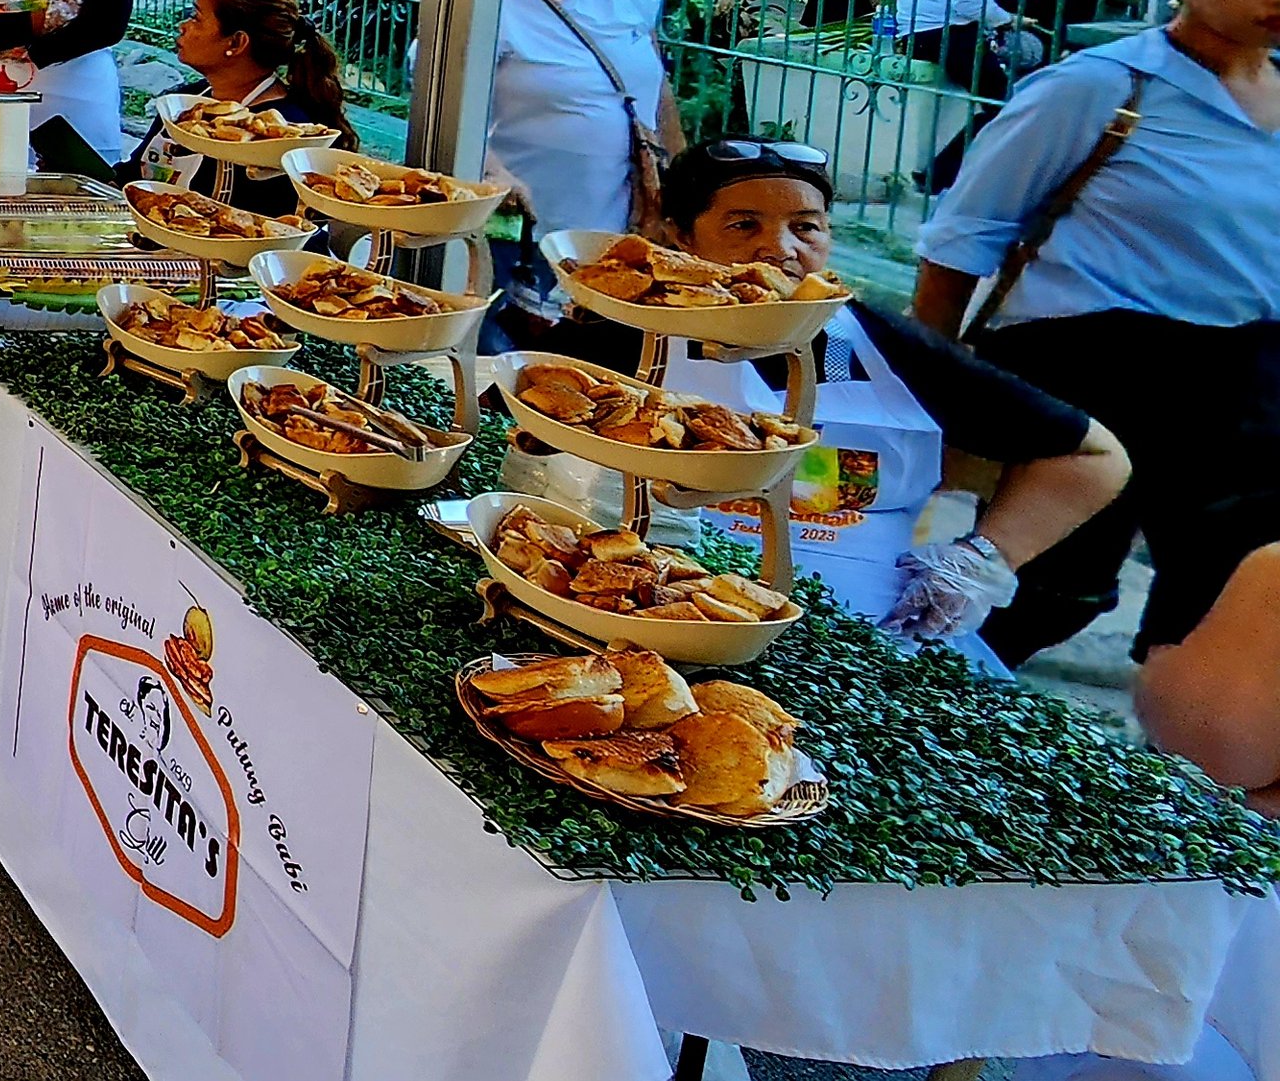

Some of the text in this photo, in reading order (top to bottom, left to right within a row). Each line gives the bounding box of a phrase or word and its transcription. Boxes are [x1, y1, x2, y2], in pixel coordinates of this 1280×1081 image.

[800, 528, 835, 542] 2023
[41, 582, 155, 639] Home of the original
[84, 690, 220, 878] TERESITA'S
[268, 814, 308, 893] Babi
